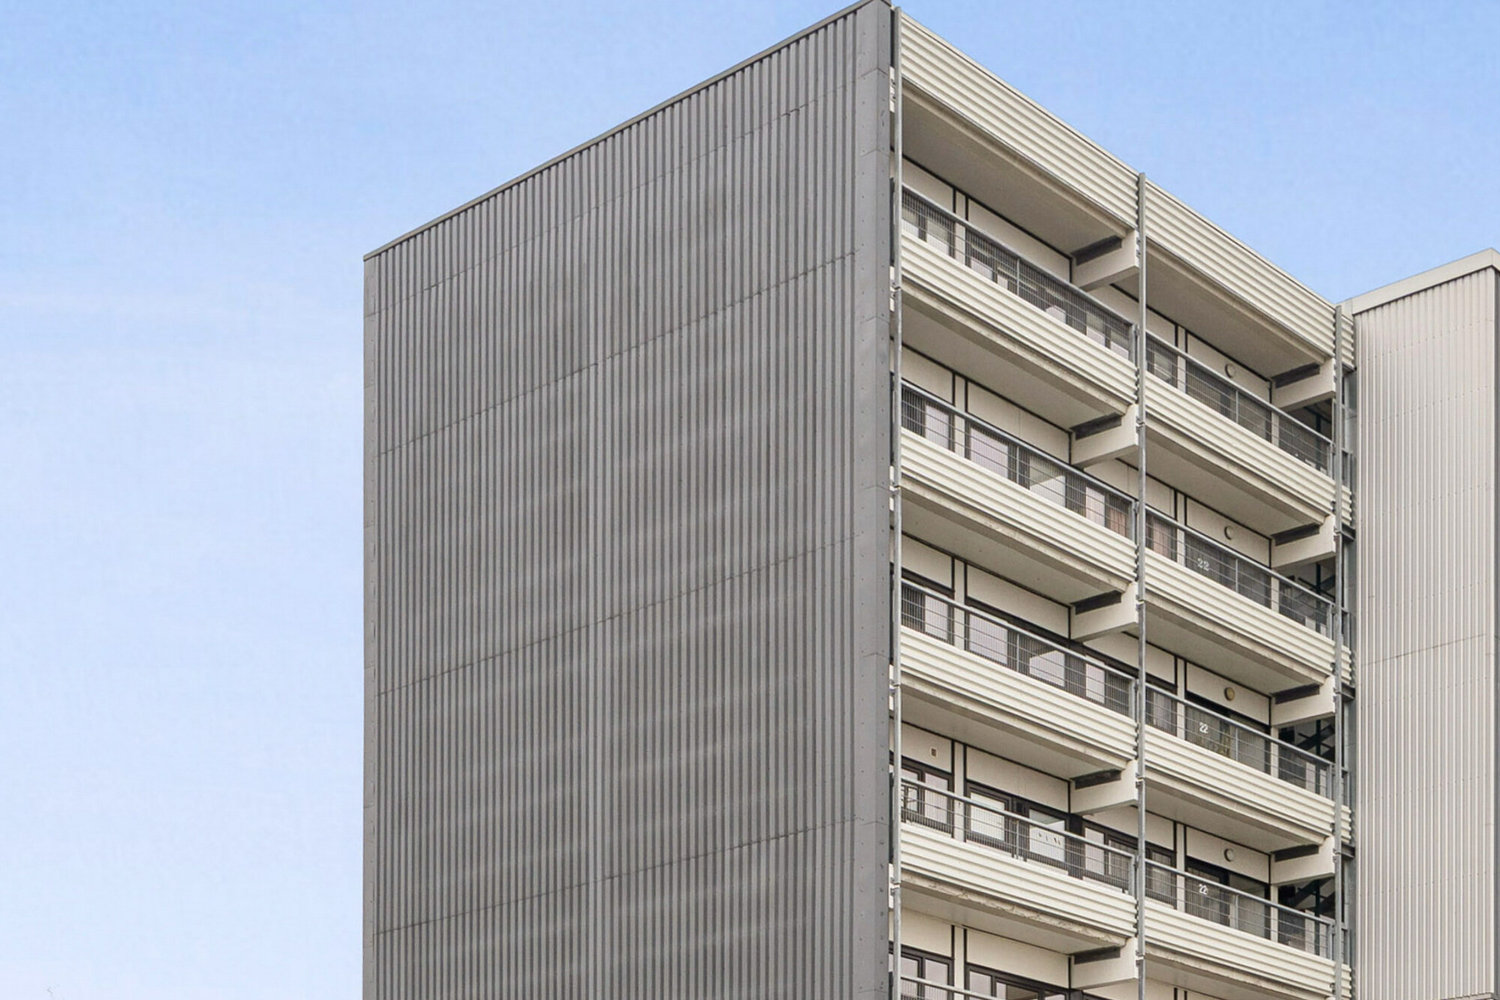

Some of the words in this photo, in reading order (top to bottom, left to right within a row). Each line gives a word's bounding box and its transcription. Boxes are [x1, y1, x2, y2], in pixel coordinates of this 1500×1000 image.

[1197, 558, 1210, 571] 22
[1199, 721, 1209, 734] 22
[1198, 883, 1209, 895] 22
